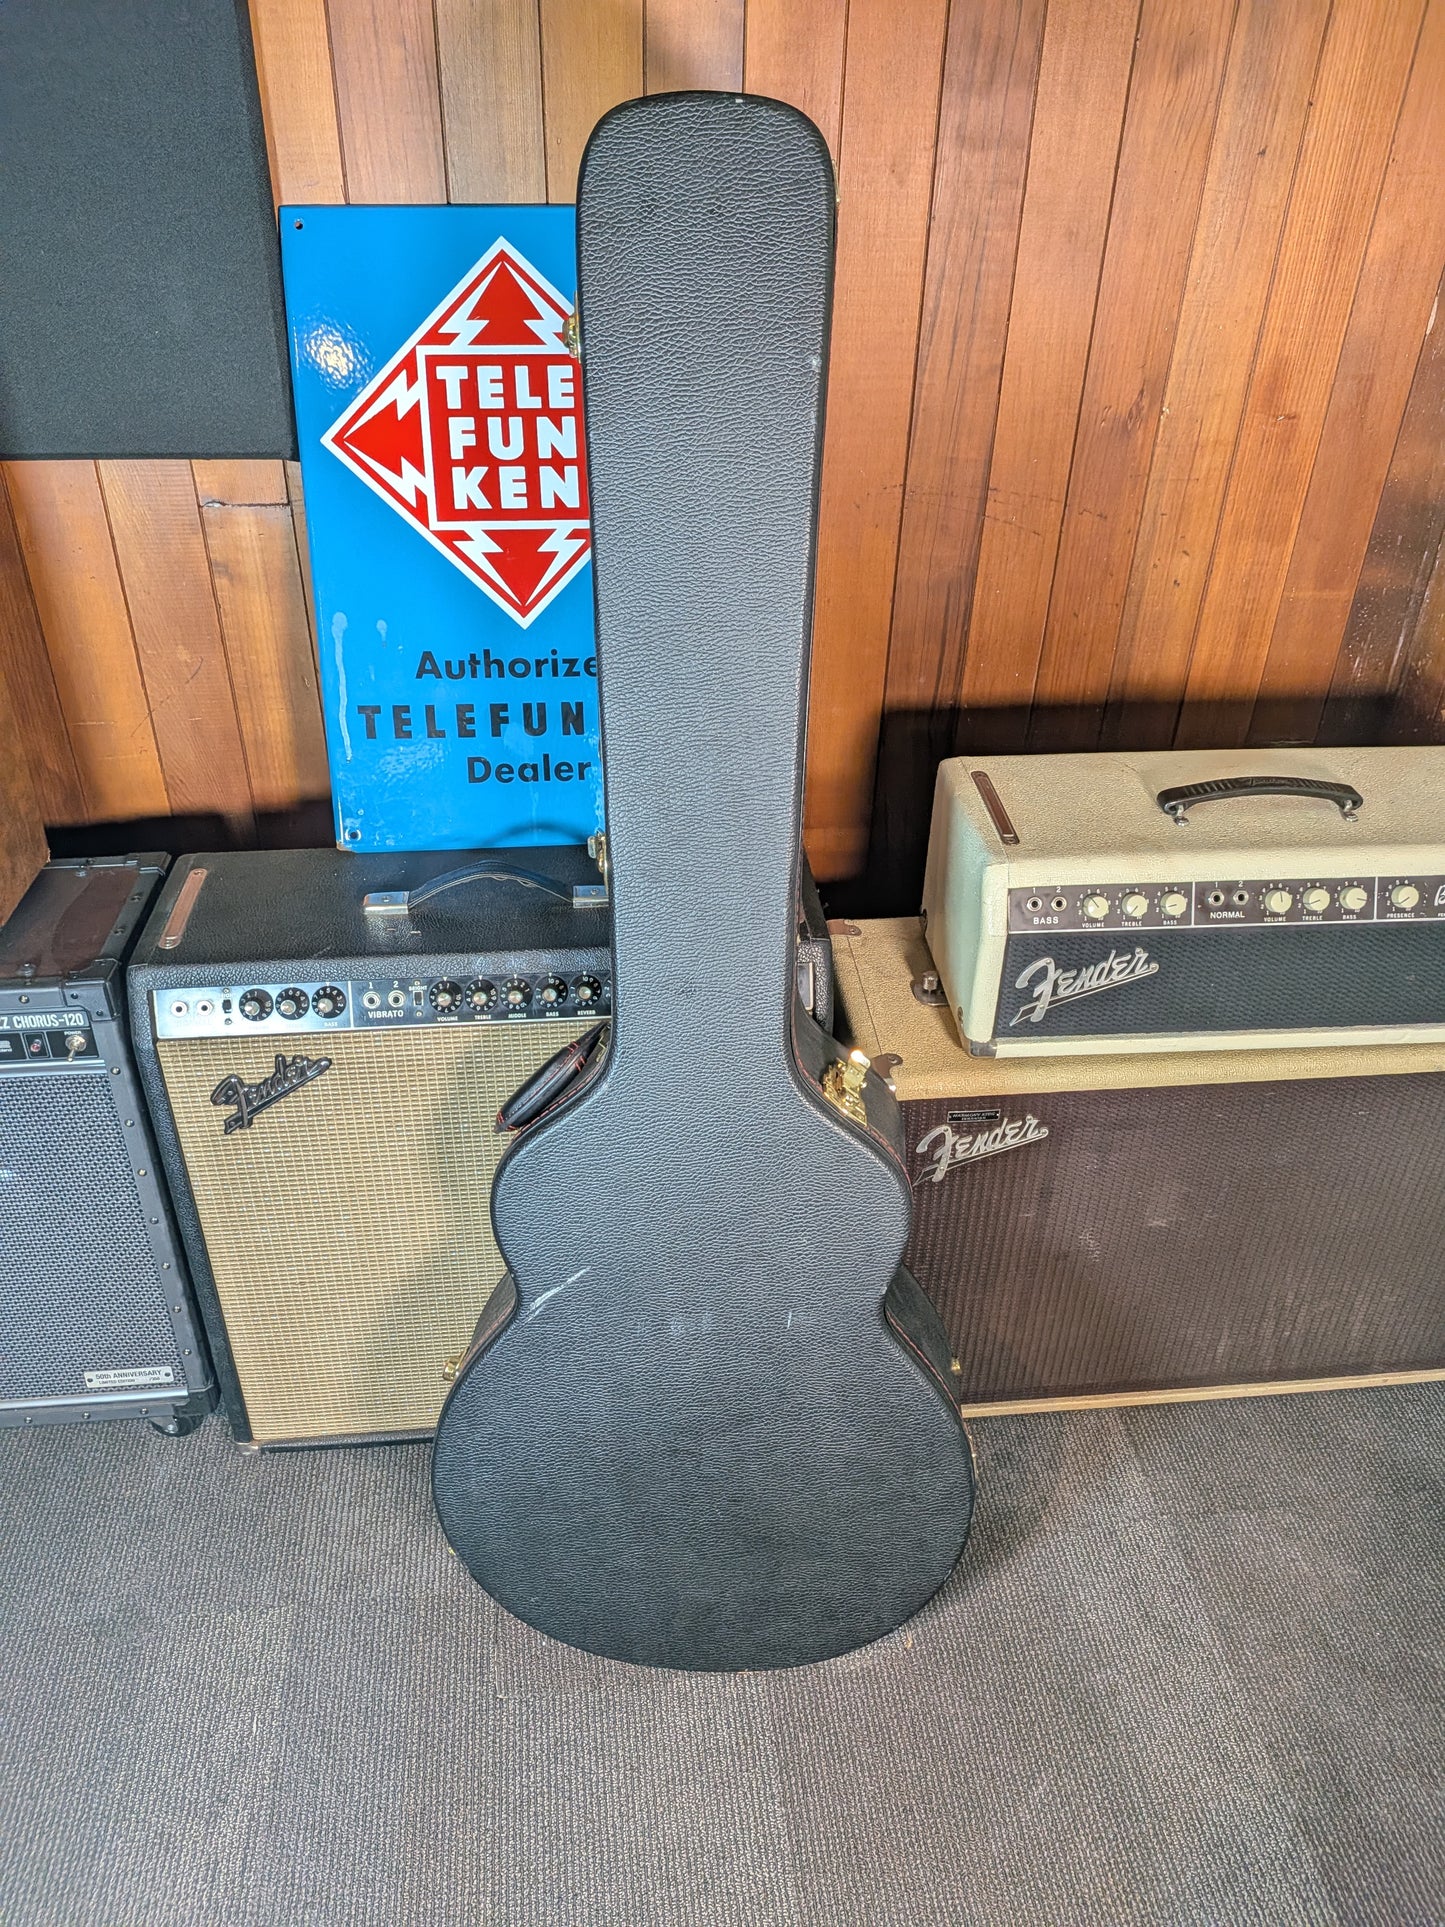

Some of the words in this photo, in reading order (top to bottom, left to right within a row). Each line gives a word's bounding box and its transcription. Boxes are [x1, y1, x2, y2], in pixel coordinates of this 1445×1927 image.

[436, 365, 576, 409] TELE
[448, 415, 578, 461] FUN
[451, 466, 581, 510] KEN
[416, 648, 597, 681] Authorize
[357, 702, 585, 741] TELEFUN
[468, 754, 591, 785] Dealer
[1033, 916, 1059, 925] BASS
[1210, 911, 1245, 919] NORMAL
[393, 980, 399, 988] 2
[1009, 946, 1159, 1026] Fender
[13, 1013, 84, 1029] CHORUS-120
[368, 1009, 404, 1019] VIBRATO
[210, 1054, 332, 1134] Fender
[912, 1113, 1049, 1187] Fender
[113, 1370, 162, 1379] ANNIVERSARY
